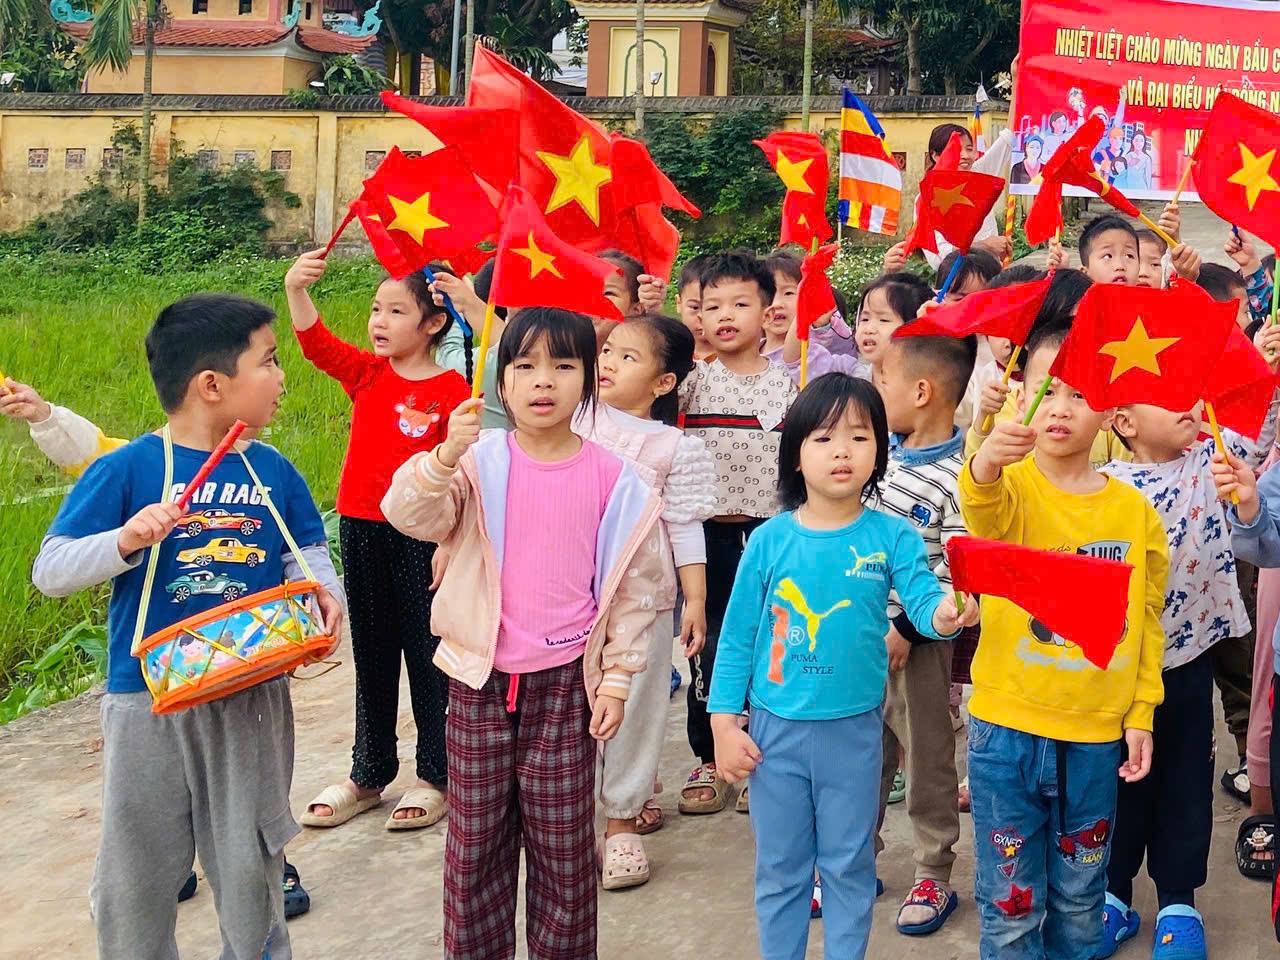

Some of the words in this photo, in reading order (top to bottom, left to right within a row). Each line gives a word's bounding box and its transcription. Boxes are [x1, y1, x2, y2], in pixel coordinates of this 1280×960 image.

[1055, 25, 1094, 64] NHIỆT
[1095, 28, 1124, 66] LIỆT
[1125, 31, 1160, 64] CHÀO
[1162, 35, 1202, 67] MỪNG
[1205, 39, 1241, 71] NGÀY
[1242, 38, 1269, 73] BẦU
[1127, 75, 1144, 106] VÀ
[1146, 80, 1169, 113] ĐẠI
[1172, 75, 1203, 110] BIỂU
[791, 654, 817, 663] PUMA
[802, 666, 834, 675] STYLE
